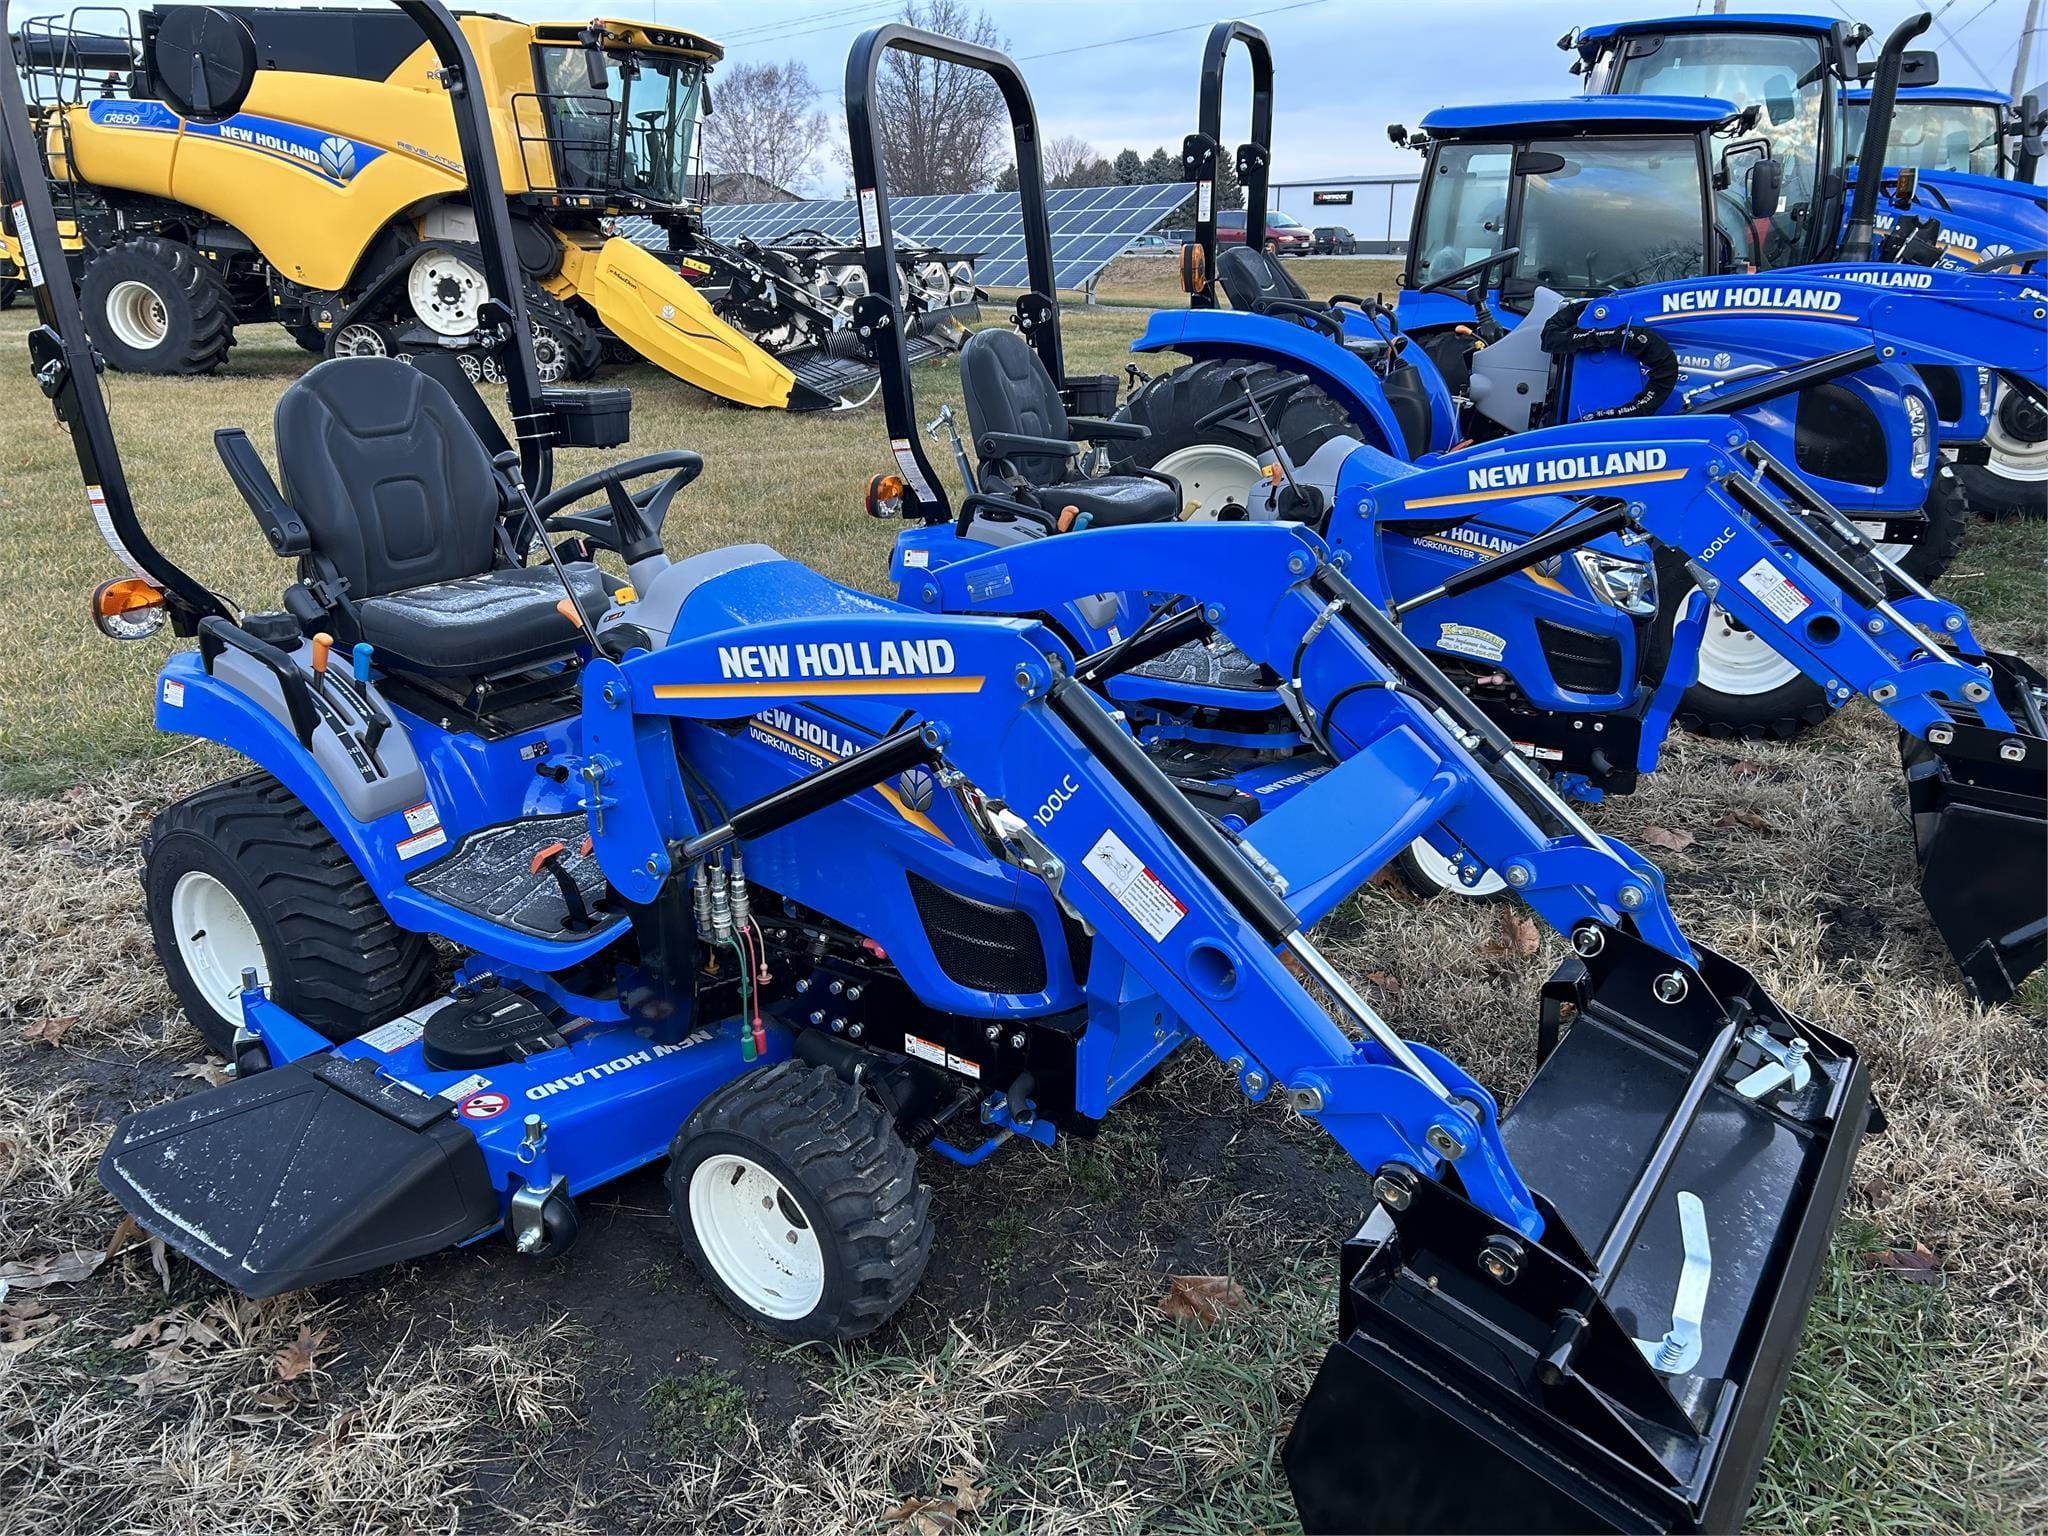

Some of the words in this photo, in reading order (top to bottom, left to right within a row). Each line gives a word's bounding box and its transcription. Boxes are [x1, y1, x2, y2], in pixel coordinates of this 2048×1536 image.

[103, 113, 139, 125] CR8.90
[219, 124, 253, 142] NEW
[255, 131, 321, 164] HOLLAND
[1845, 271, 1933, 289] HOLLAND
[1662, 289, 1719, 313] NEW
[1724, 287, 1842, 311] HOLLAND
[1677, 354, 1711, 368] LAND
[1468, 463, 1530, 490] NEW
[1536, 448, 1667, 483] HOLLAND
[1413, 536, 1475, 560] WORKMASTER
[1698, 526, 1737, 562] 100LC
[718, 644, 790, 679] NEW
[795, 638, 956, 677] HOLLAND
[750, 726, 824, 769] WORKMASTER
[795, 717, 862, 758] HOLLA
[1033, 773, 1080, 828] 100LC
[653, 1029, 714, 1058] NEW
[525, 1050, 652, 1101] HOLLAND
